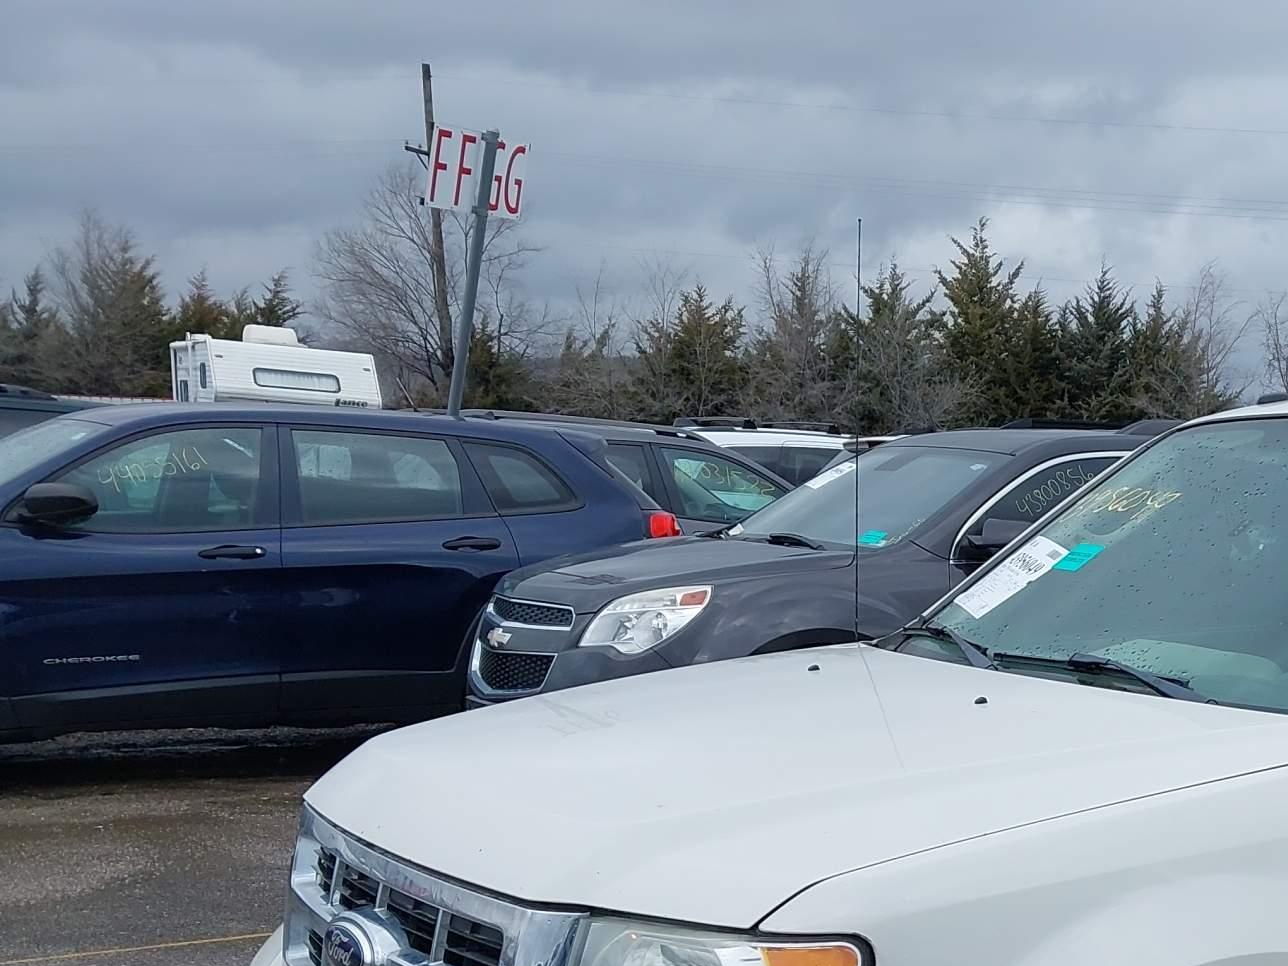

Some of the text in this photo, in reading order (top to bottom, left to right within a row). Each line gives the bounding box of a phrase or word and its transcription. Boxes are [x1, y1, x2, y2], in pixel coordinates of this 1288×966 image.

[1015, 464, 1094, 516] 43800856
[43, 655, 140, 665] CHEROKEE
[328, 930, 354, 966] Ford
